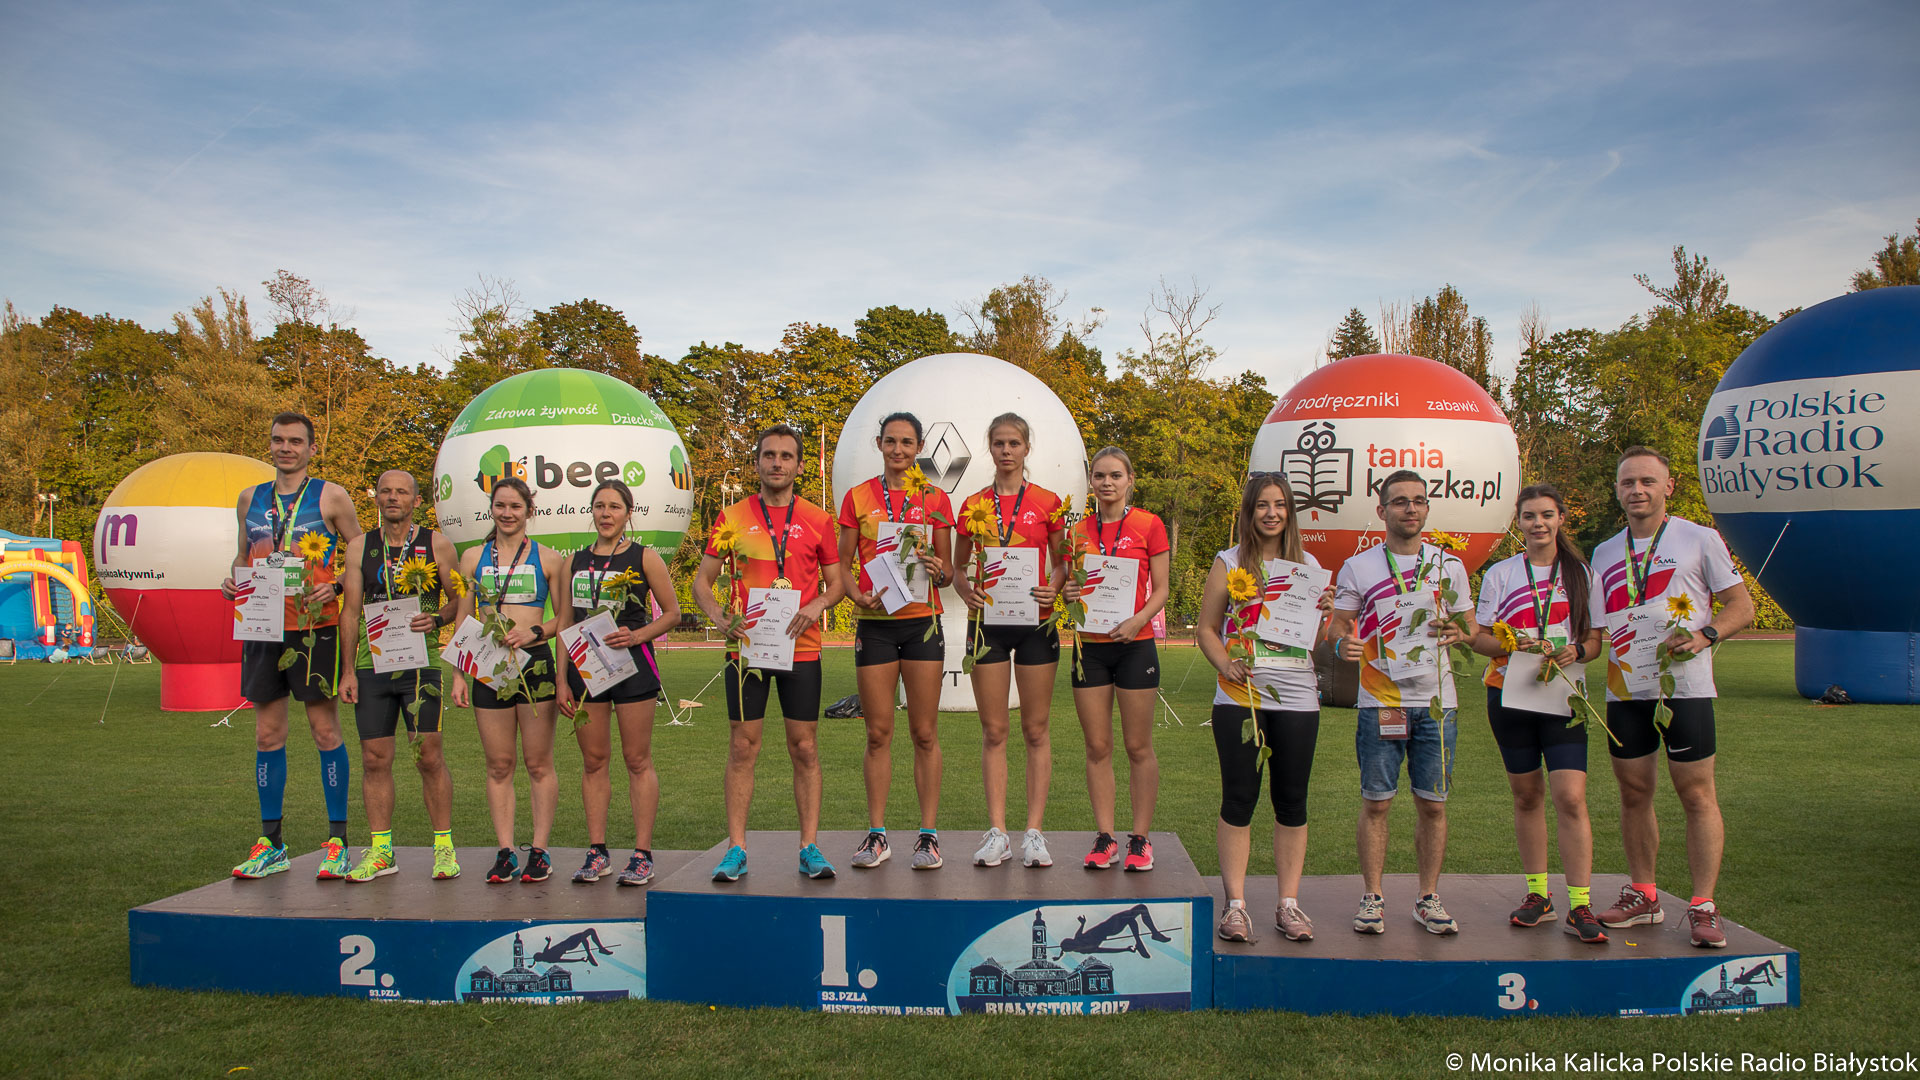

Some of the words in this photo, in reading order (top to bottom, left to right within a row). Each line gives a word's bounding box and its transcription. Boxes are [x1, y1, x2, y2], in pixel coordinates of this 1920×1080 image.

[484, 407, 536, 421] Zdrowa
[540, 403, 599, 418] żywność
[1294, 392, 1399, 413] podręczniki
[1426, 399, 1480, 413] zabawki
[1746, 388, 1886, 422] Polskie
[611, 413, 654, 426] Dziecko
[1743, 420, 1884, 457] Radio
[1366, 441, 1444, 468] tania
[1366, 468, 1502, 507] kzka.pl
[1703, 455, 1885, 499] Białystok
[556, 504, 575, 515] dla
[340, 934, 395, 988] 2.
[820, 914, 878, 989] 1.
[821, 991, 868, 1002] 93.PZLA
[1497, 972, 1539, 1010] 3.
[1090, 1000, 1130, 1016] 2017
